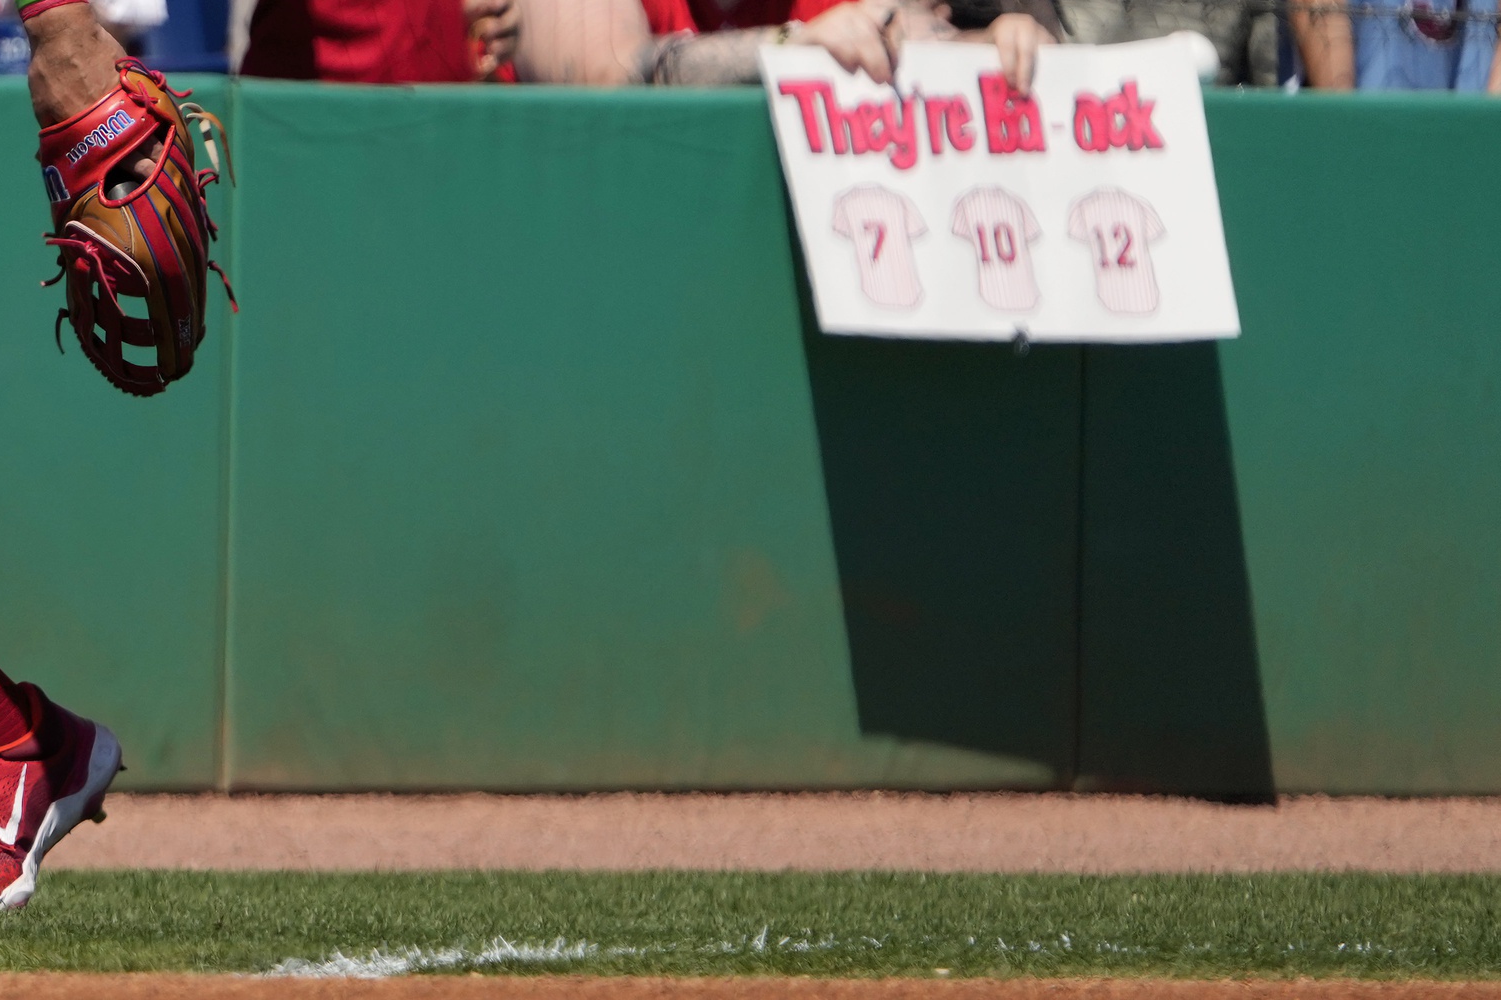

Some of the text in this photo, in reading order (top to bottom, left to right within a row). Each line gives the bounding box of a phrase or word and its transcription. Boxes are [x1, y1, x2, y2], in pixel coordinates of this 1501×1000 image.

[65, 108, 136, 166] Wilson
[779, 78, 977, 171] They're
[863, 221, 1135, 268] 7 10 12
